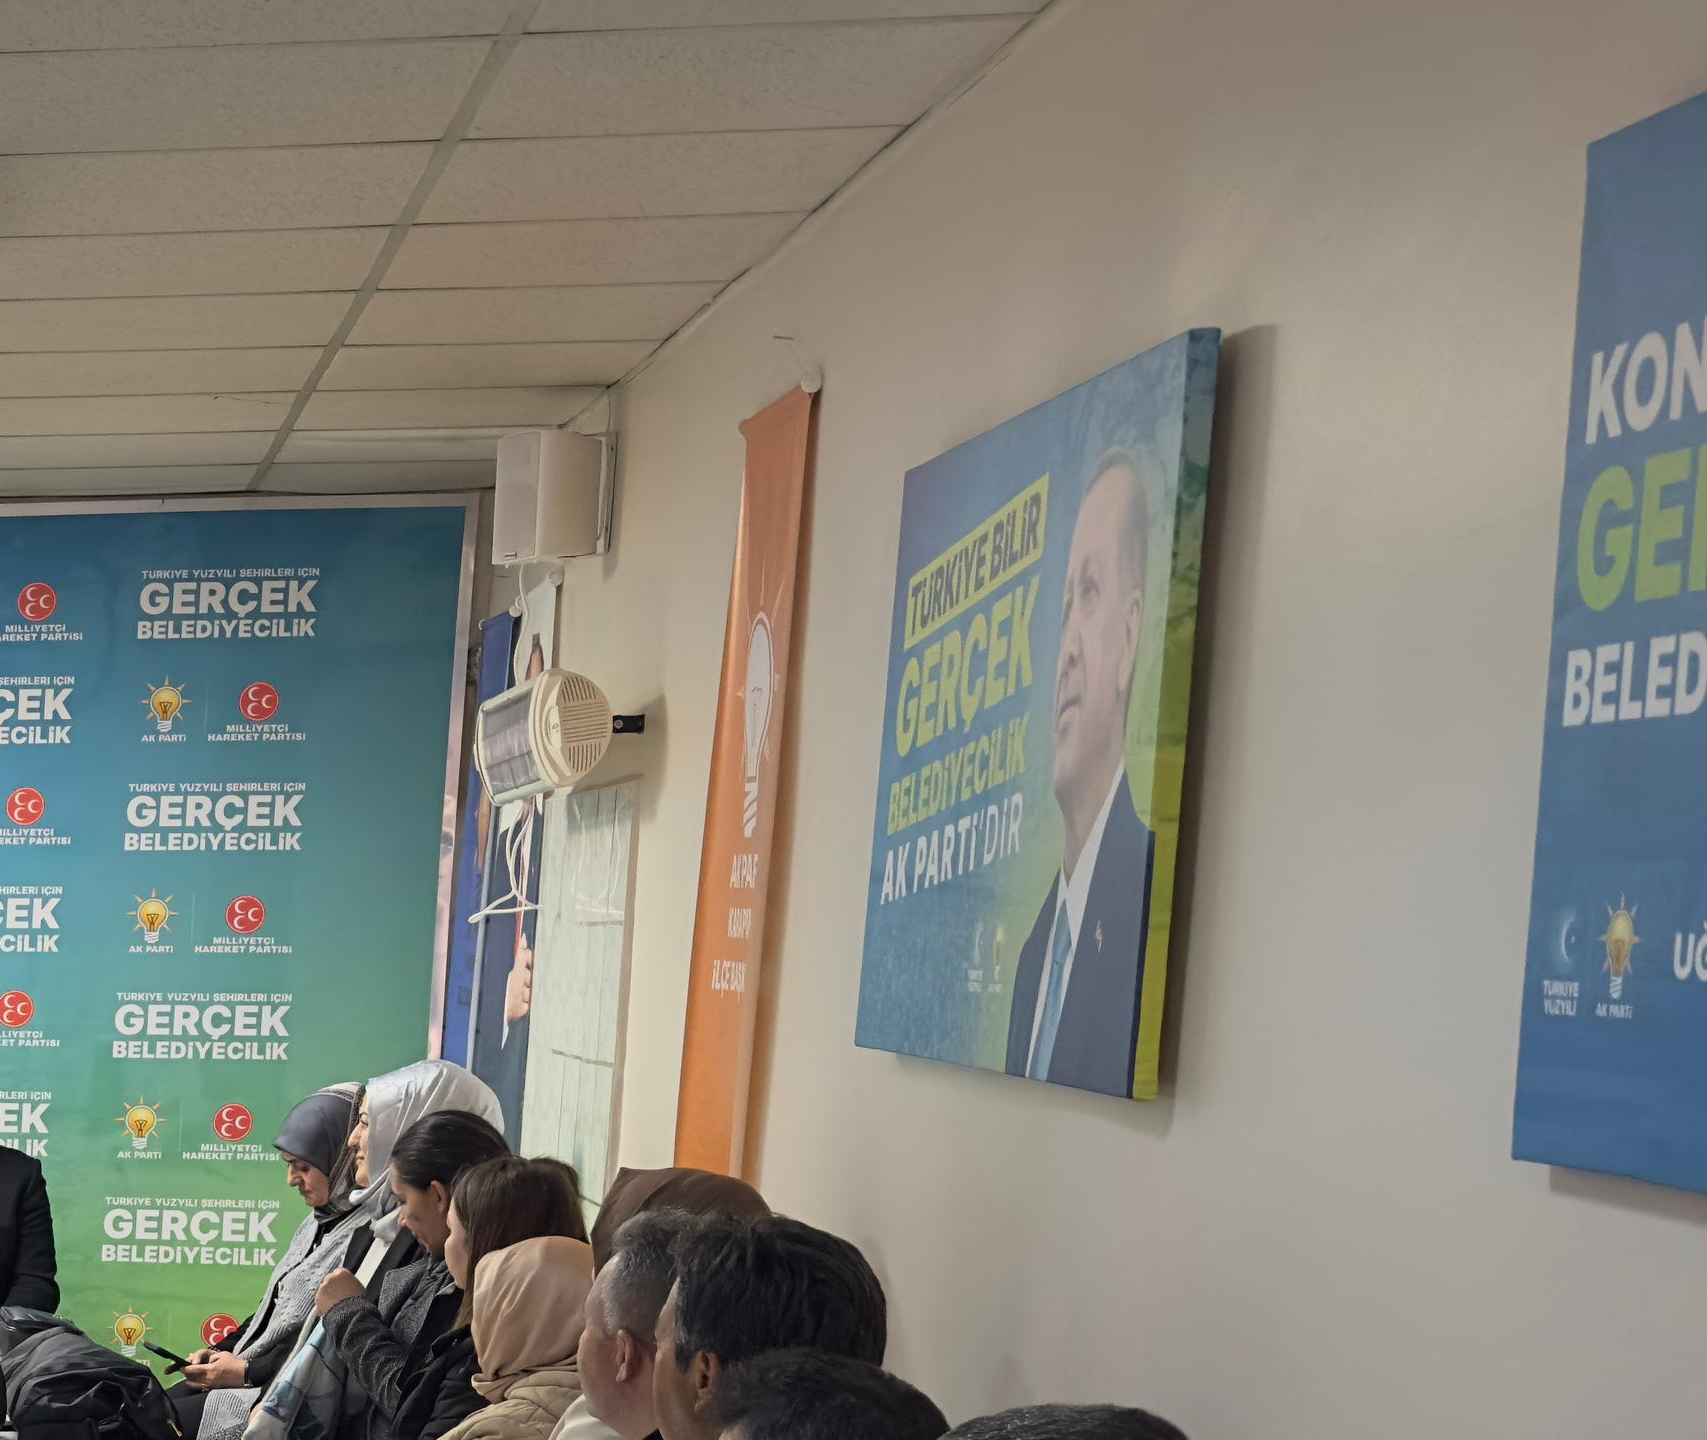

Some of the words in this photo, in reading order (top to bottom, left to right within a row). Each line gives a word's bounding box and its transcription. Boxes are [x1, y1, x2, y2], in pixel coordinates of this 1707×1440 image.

[140, 580, 317, 617] GERÇEK
[896, 575, 1040, 757] GERÇEK
[208, 733, 260, 741] HAREKET
[127, 795, 303, 831] GERÇEK
[880, 842, 911, 904] AK
[115, 1004, 290, 1040] GERÇEK
[183, 1152, 234, 1160] HAREKET
[102, 1208, 277, 1246] GERÇEK
